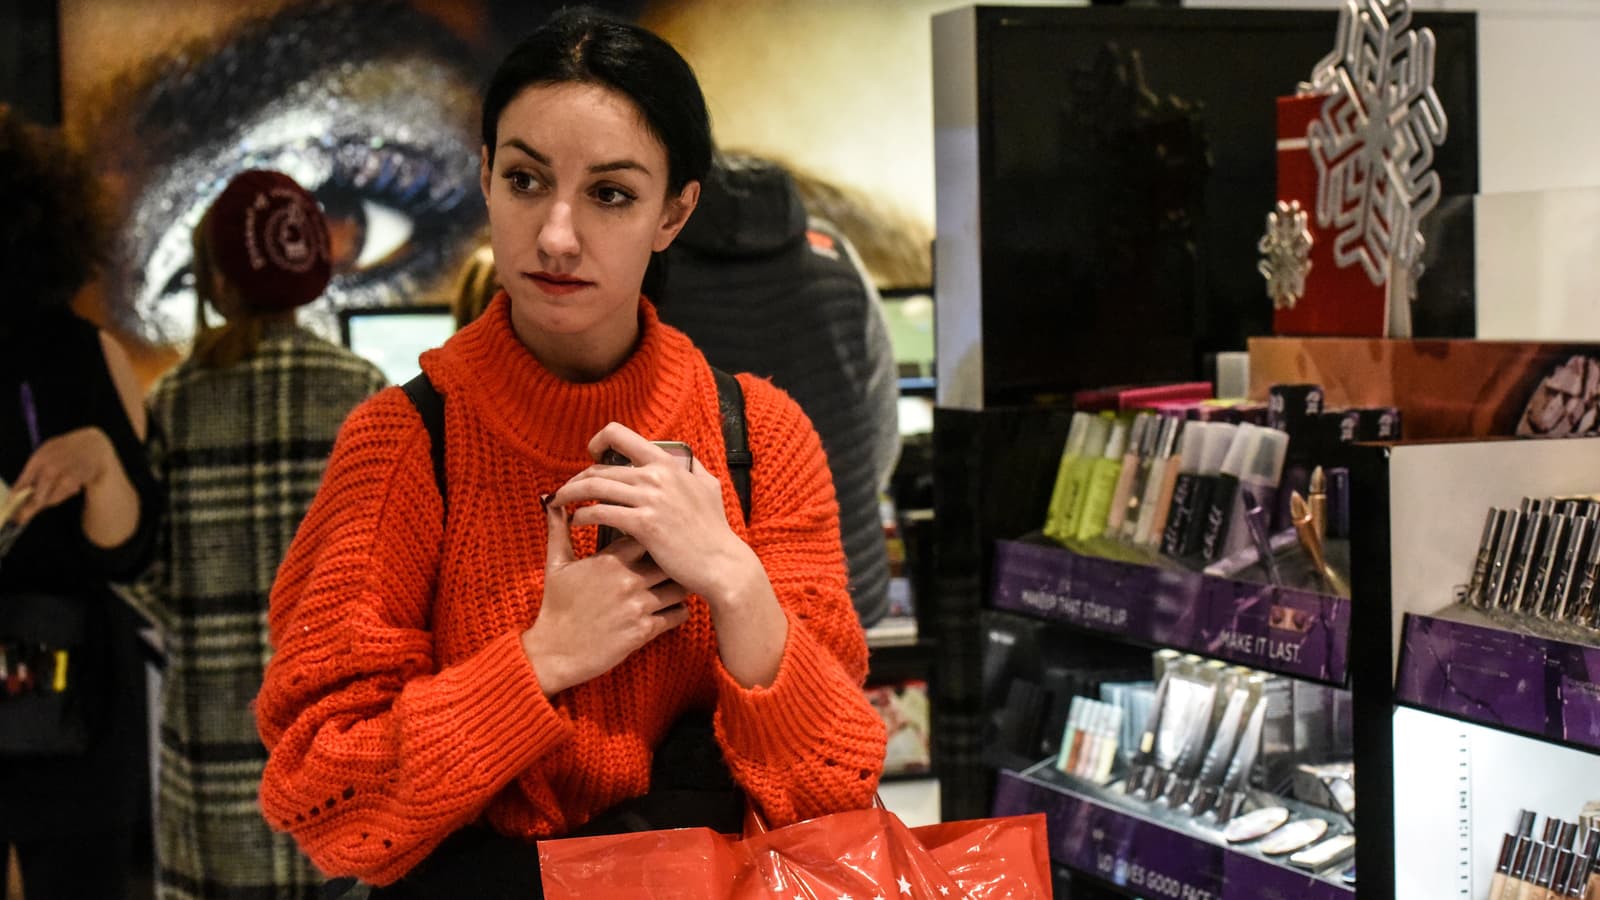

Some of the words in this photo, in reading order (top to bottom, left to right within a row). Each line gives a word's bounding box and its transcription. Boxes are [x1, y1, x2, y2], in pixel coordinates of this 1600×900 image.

[1220, 629, 1253, 654] MAKE
[1255, 636, 1267, 655] IT
[1146, 870, 1181, 899] GOOD
